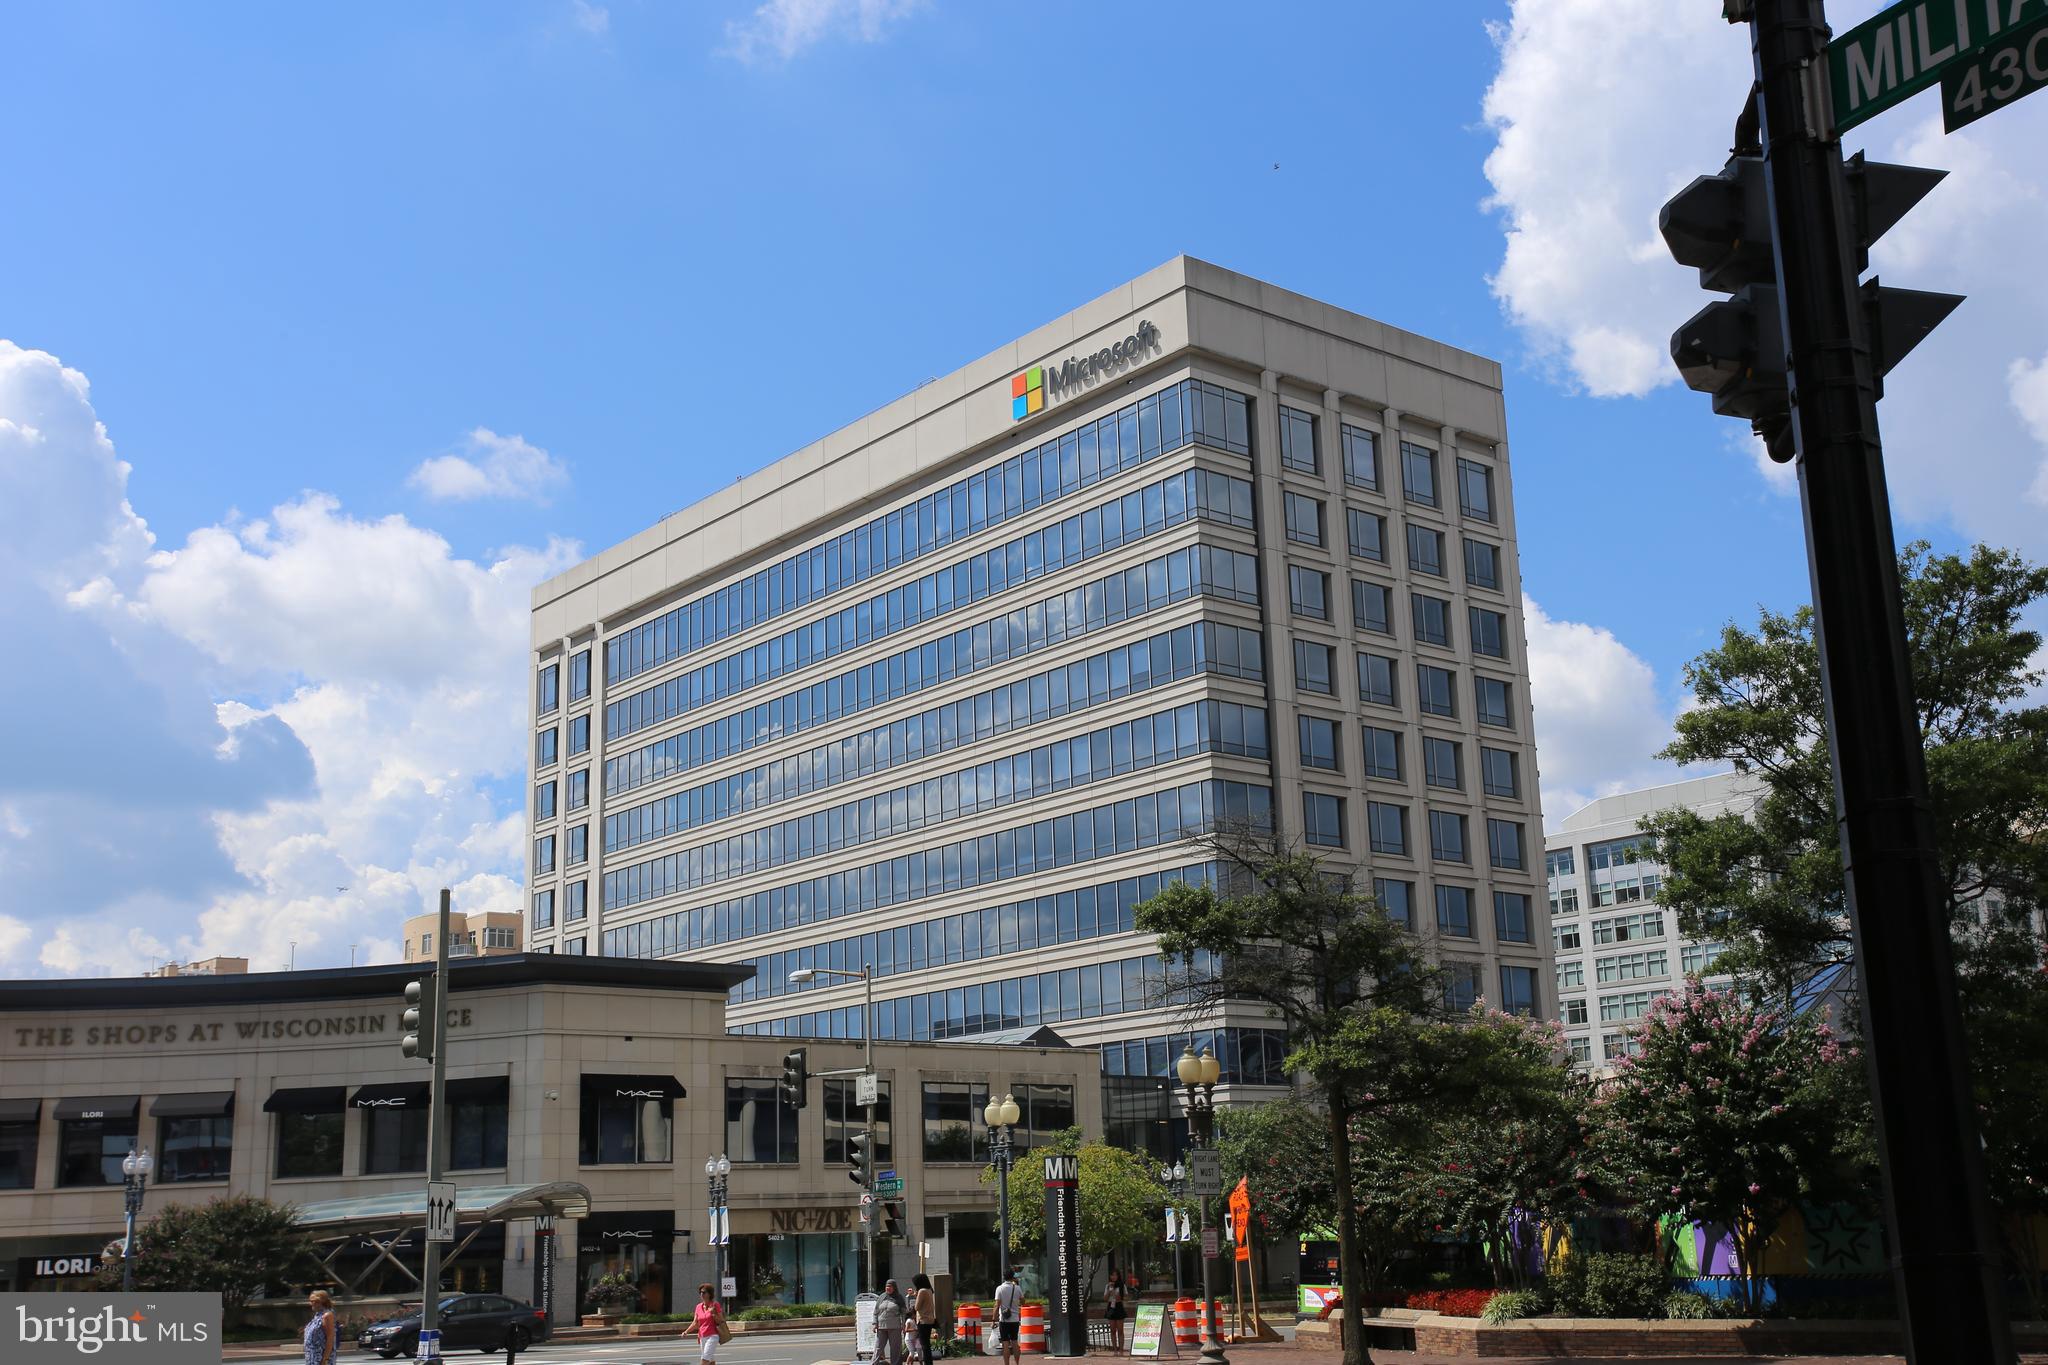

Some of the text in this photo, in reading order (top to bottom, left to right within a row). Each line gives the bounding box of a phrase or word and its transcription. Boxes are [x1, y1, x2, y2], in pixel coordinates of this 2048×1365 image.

[1049, 319, 1157, 396] Microsoft
[16, 1028, 74, 1047] THE
[87, 1024, 177, 1046] SHOPS
[188, 1023, 224, 1042] AT
[234, 1014, 386, 1039] WISCONSIN
[82, 1111, 104, 1119] ILORI
[1045, 1157, 1063, 1179] M
[1064, 1157, 1078, 1179] M
[1200, 1168, 1214, 1176] MUST
[875, 1182, 896, 1191] Western
[535, 1216, 549, 1231] M
[1057, 1188, 1069, 1313] Friendship Heights Station
[36, 1258, 91, 1276] ILORI
